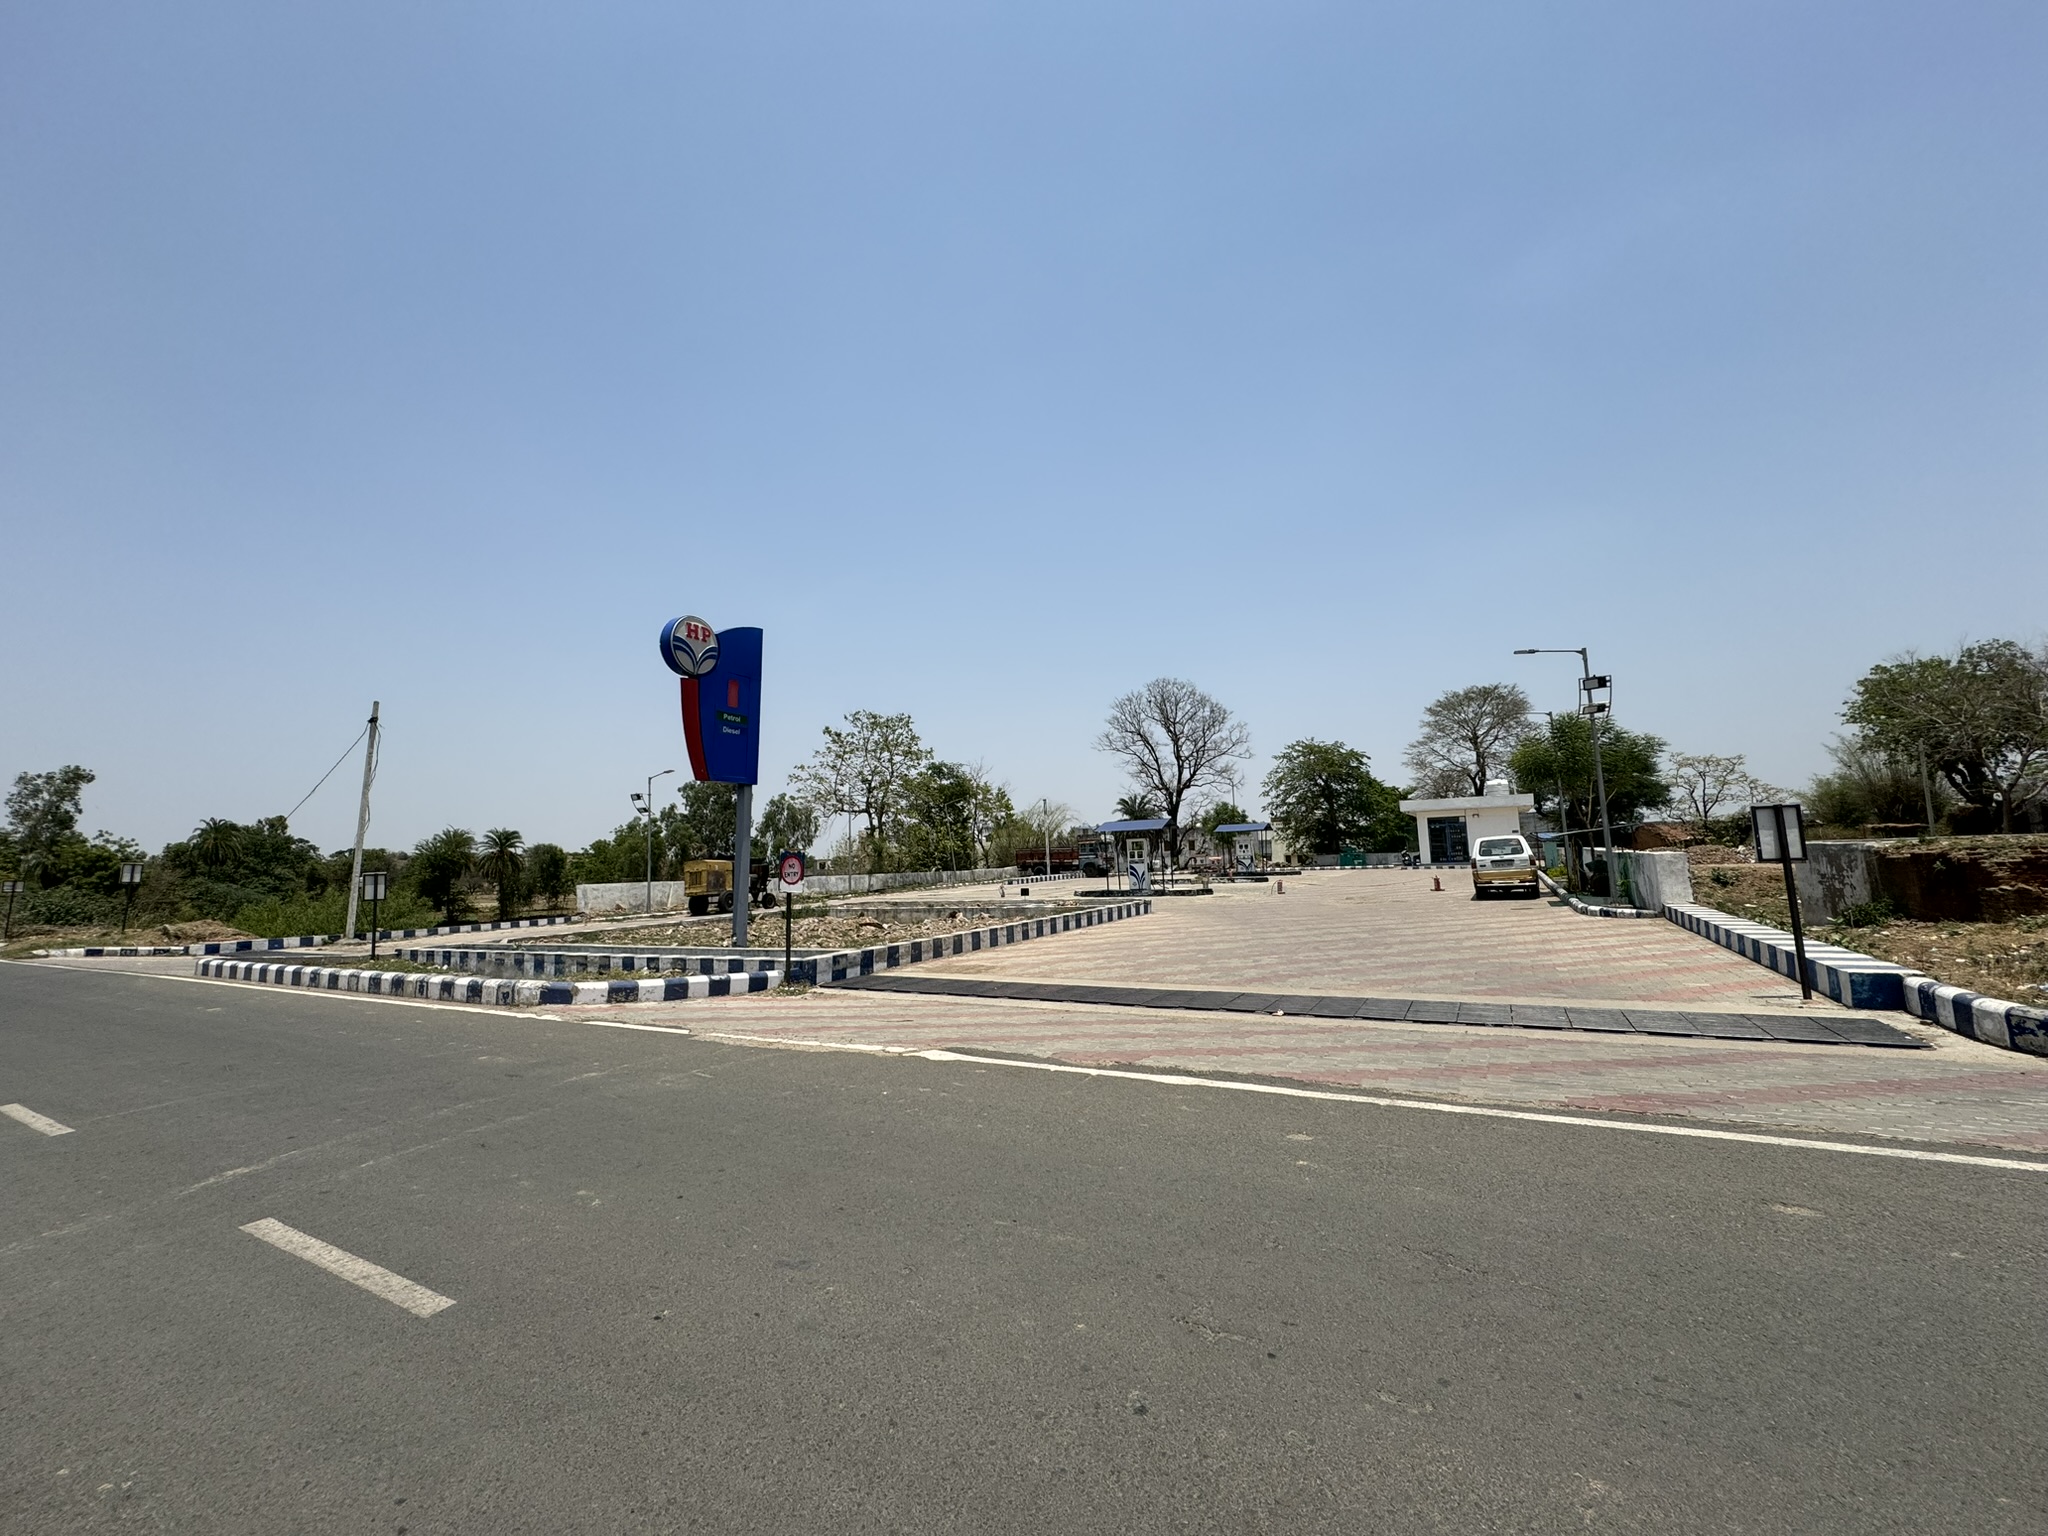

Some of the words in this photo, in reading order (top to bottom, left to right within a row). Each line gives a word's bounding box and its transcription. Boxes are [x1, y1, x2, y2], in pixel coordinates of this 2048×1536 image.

[685, 621, 712, 643] HP
[723, 713, 741, 722] Petrol
[722, 725, 741, 735] Diesel
